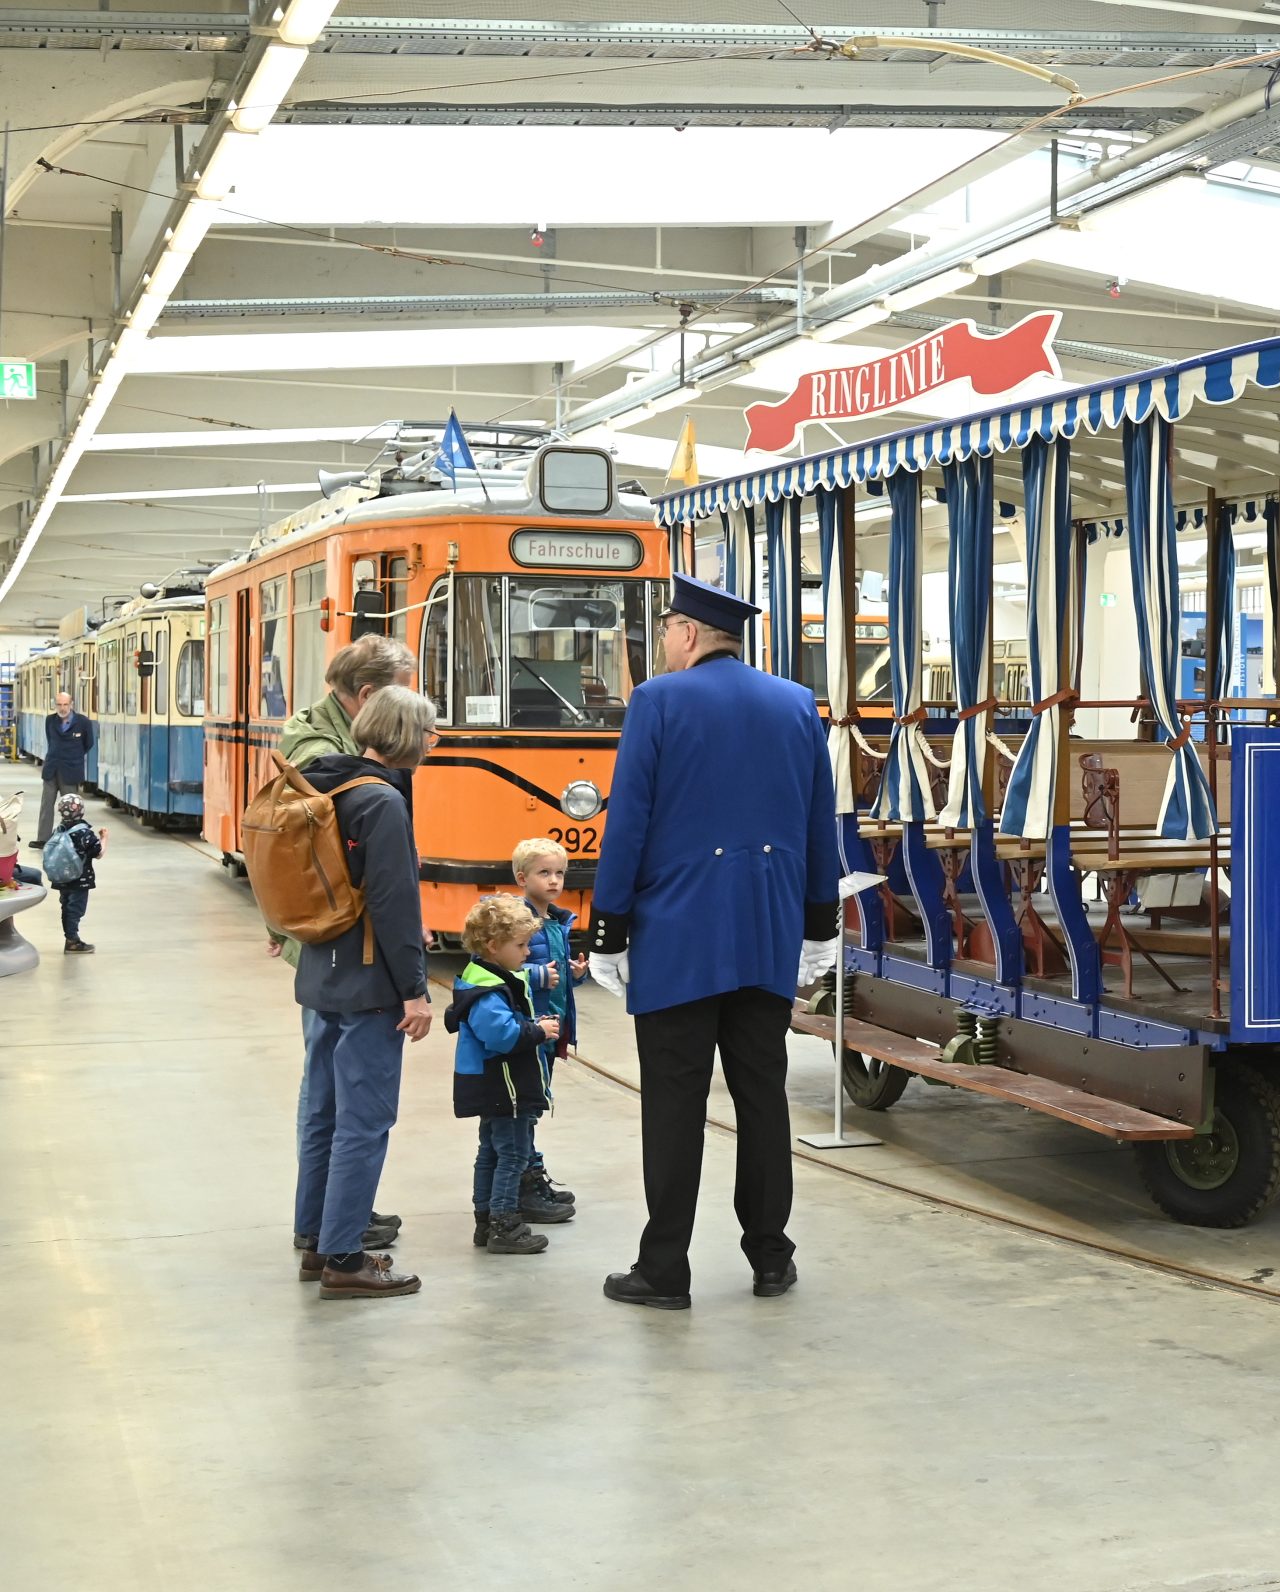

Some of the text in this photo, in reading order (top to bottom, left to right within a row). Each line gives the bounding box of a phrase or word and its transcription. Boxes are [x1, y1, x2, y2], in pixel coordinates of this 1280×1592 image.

[810, 334, 946, 417] RINGLINIE
[528, 539, 621, 560] Fahrschule
[547, 827, 603, 853] 292
